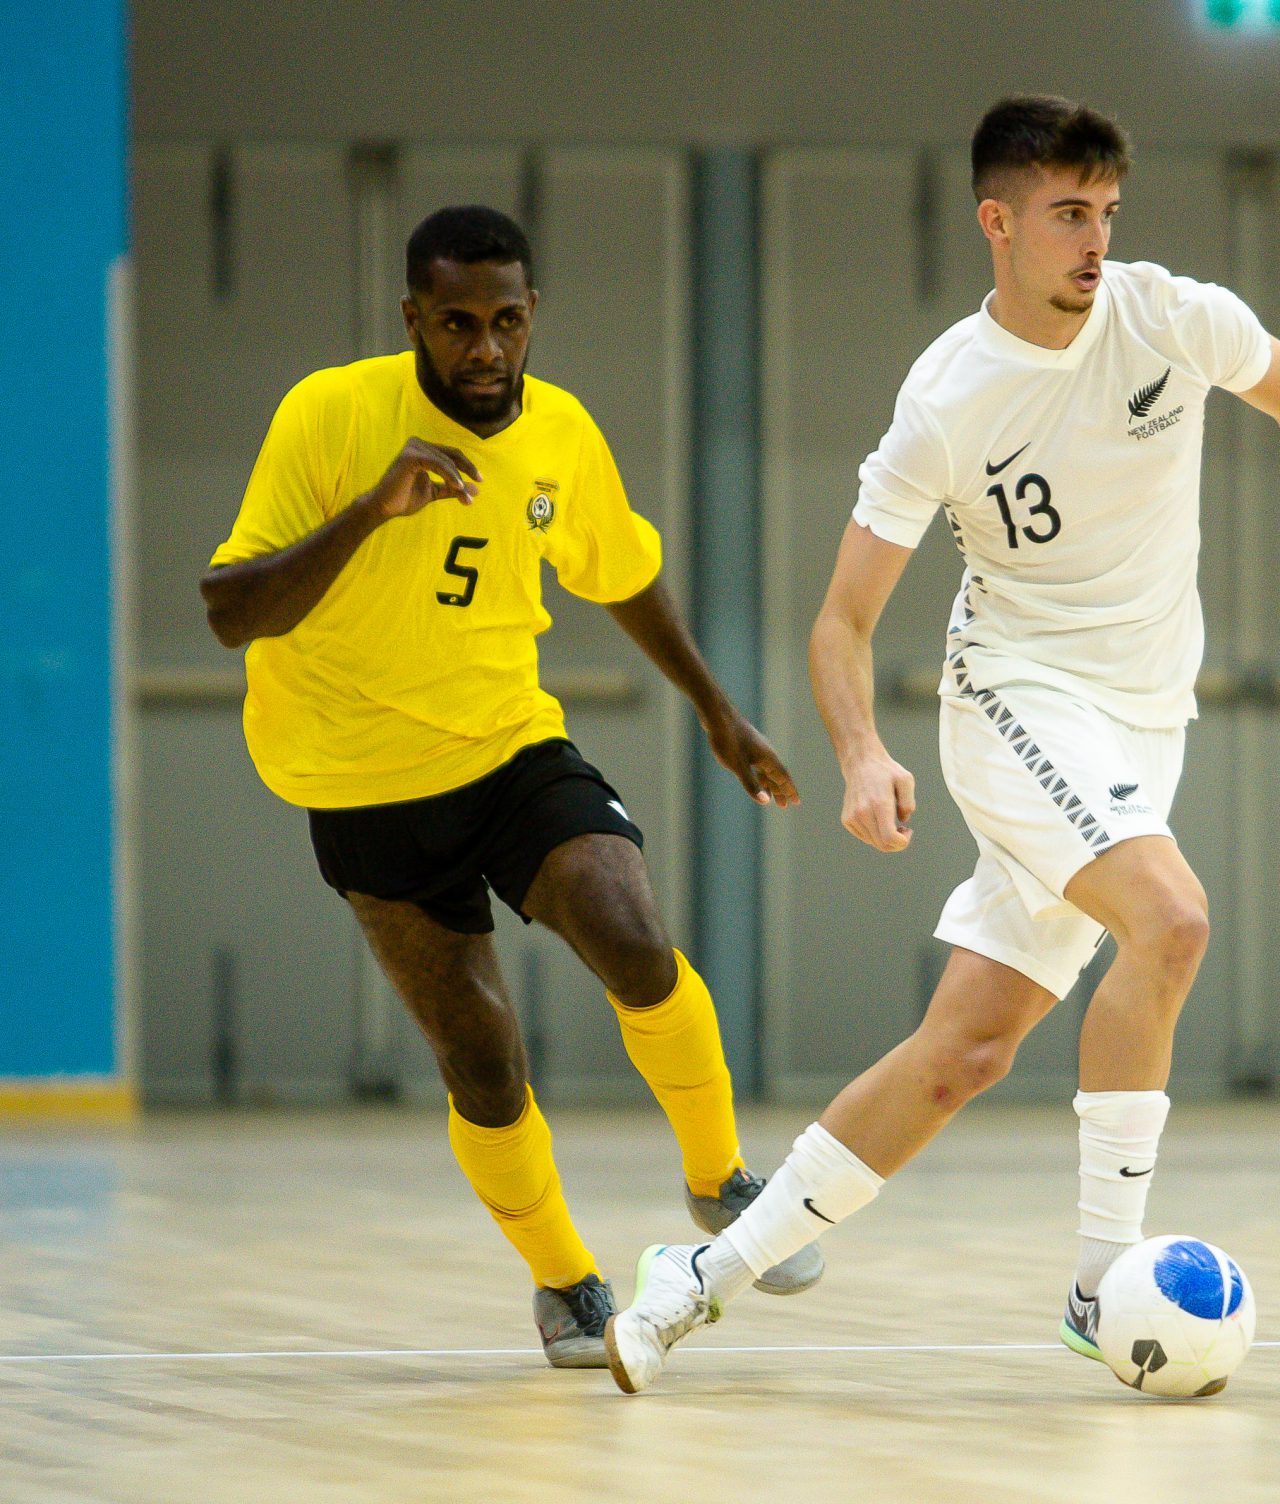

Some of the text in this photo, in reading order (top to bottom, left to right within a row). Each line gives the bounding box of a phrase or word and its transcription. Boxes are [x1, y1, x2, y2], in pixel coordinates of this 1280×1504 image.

[1127, 405, 1184, 437] NEW ZEALAND
[1136, 416, 1181, 441] FOOTBALL
[986, 473, 1062, 549] 13
[436, 535, 489, 607] 5
